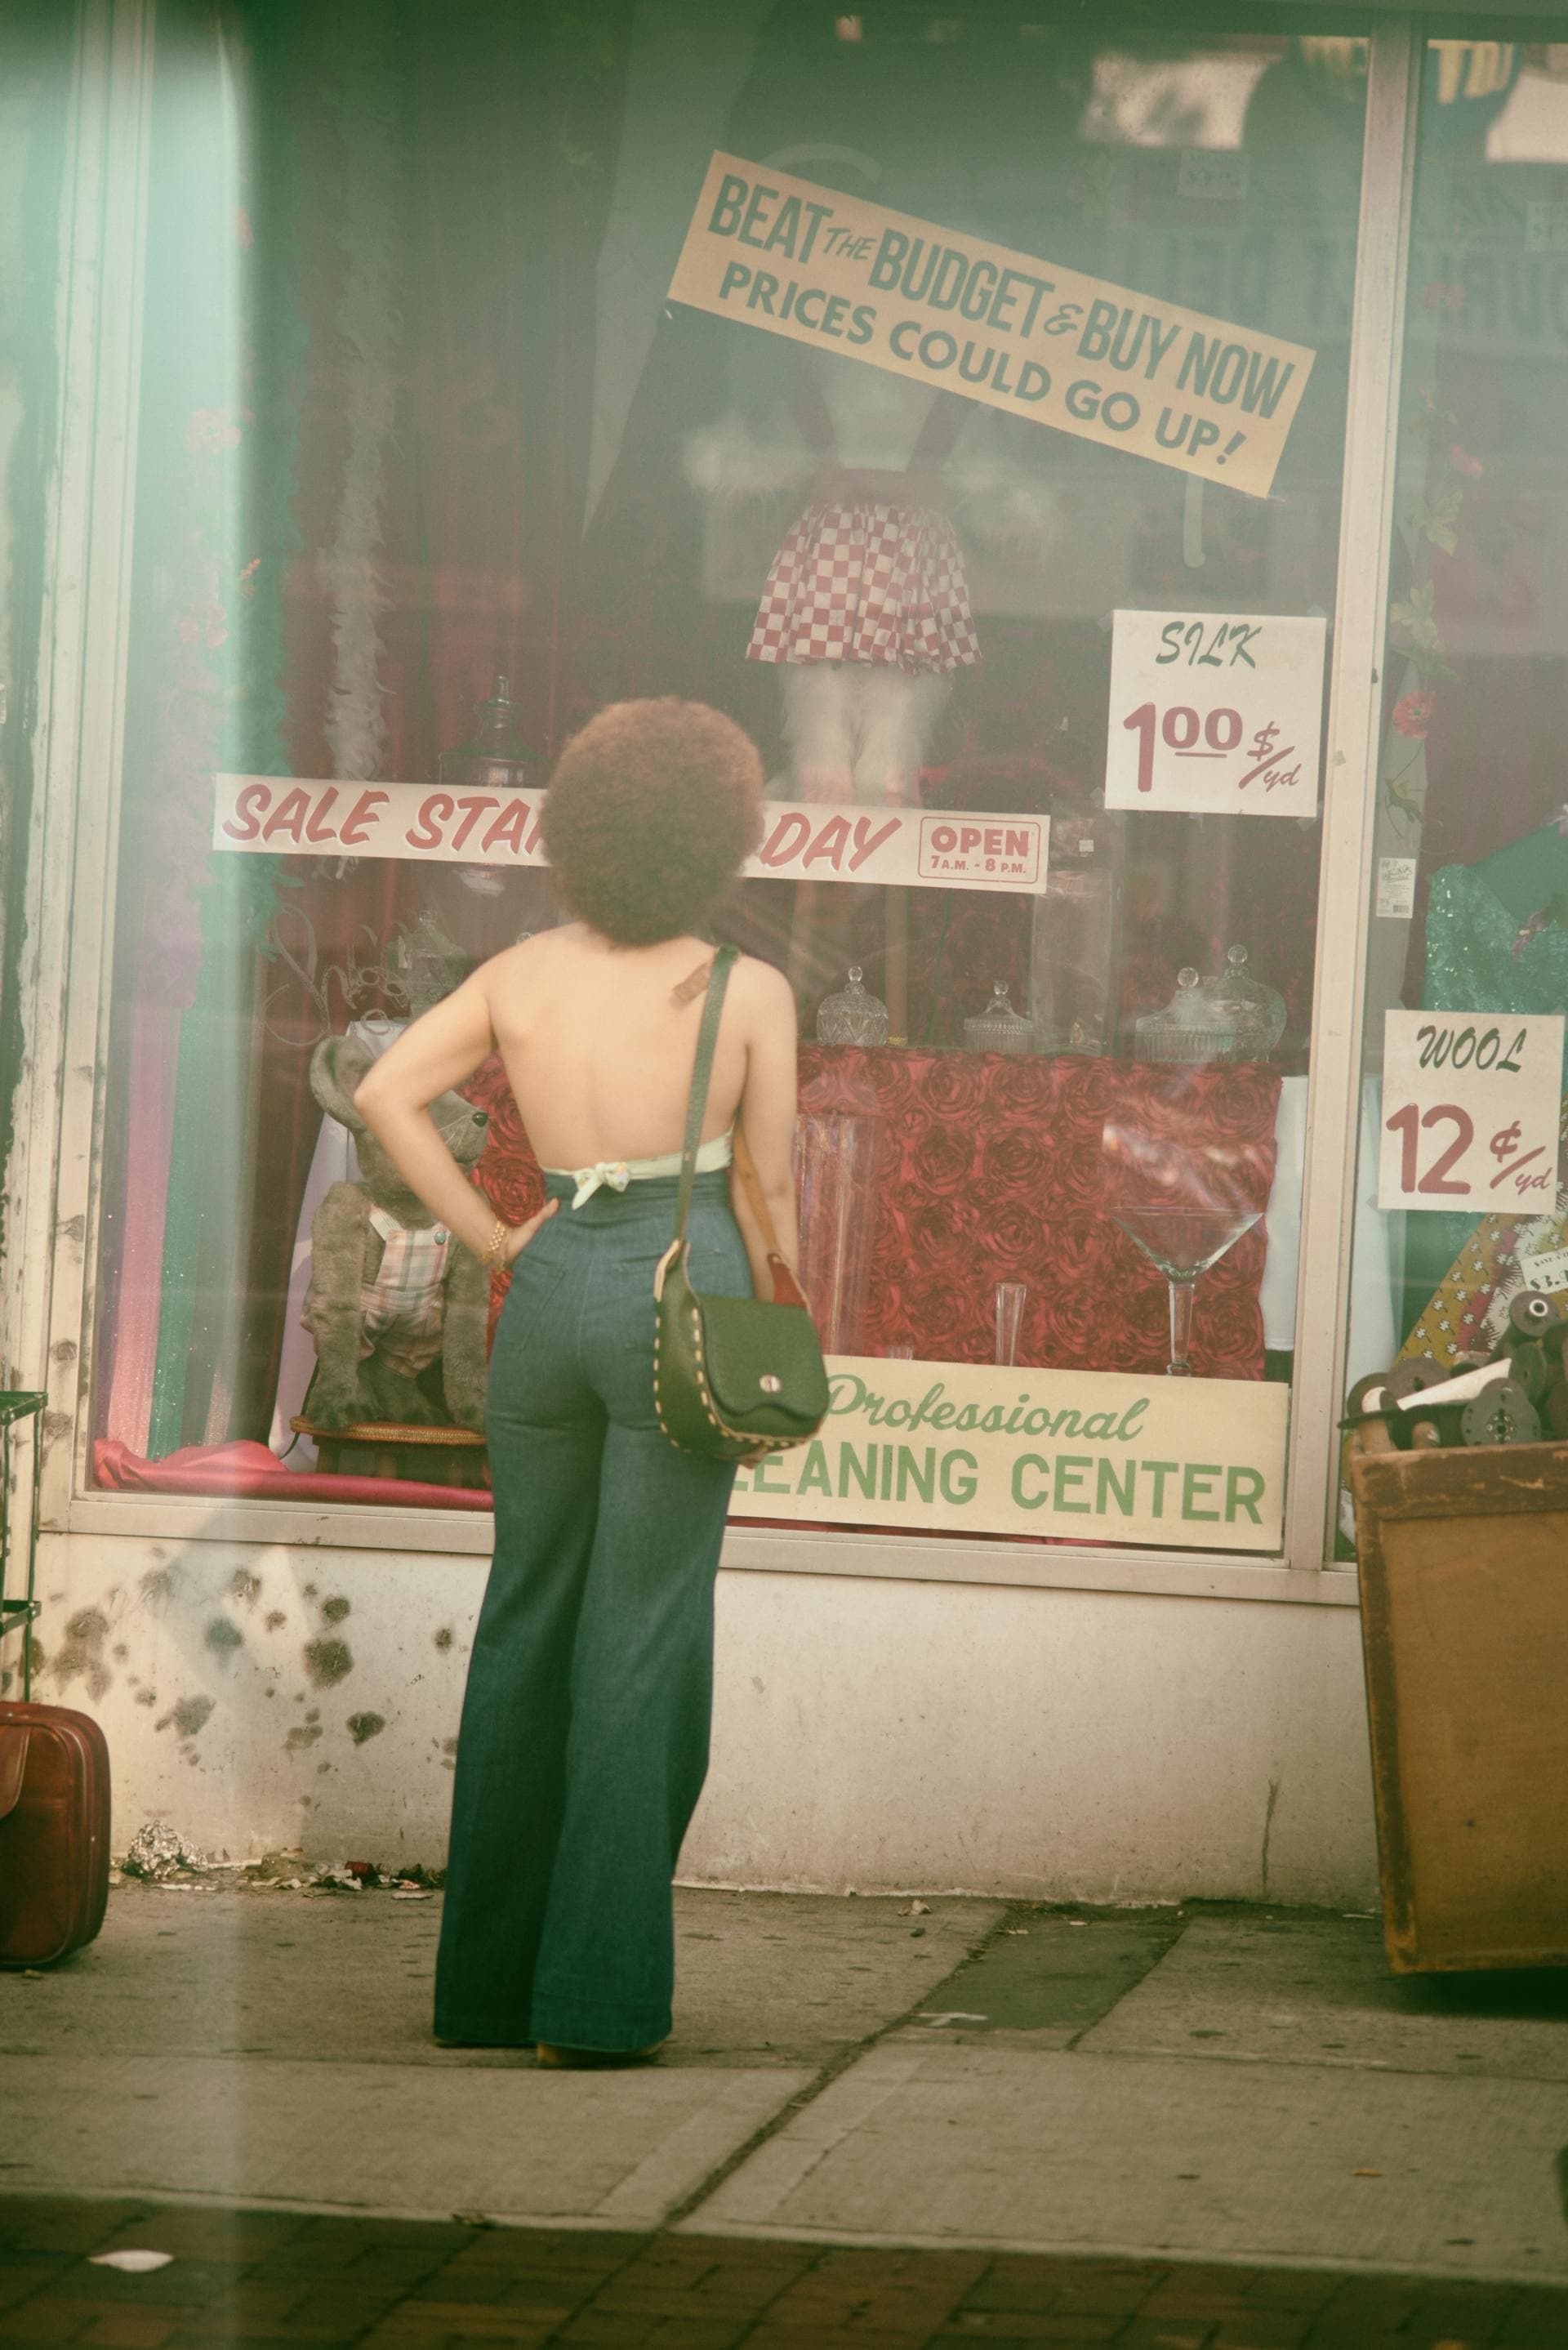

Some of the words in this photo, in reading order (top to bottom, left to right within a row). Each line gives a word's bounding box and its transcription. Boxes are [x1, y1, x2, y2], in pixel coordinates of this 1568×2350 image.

[706, 173, 835, 265] BEAT
[824, 228, 877, 261] THE
[868, 227, 1055, 338] BUDGET
[1044, 304, 1084, 336] &
[1077, 298, 1182, 380] BUY
[1176, 332, 1295, 419] NOW
[718, 261, 877, 345] PRICES
[889, 320, 1052, 402] COULD
[1065, 379, 1140, 432] GO
[1155, 408, 1247, 465] UP!
[1156, 621, 1263, 669] SILK
[222, 783, 390, 845] SALE
[931, 825, 1030, 858] OPEN
[985, 858, 996, 872] 8
[1416, 1024, 1527, 1073] WOOL
[1386, 1103, 1474, 1195] 12
[822, 1374, 1150, 1442] Professional
[734, 1440, 978, 1505] EANING
[1011, 1453, 1266, 1525] CENTER
